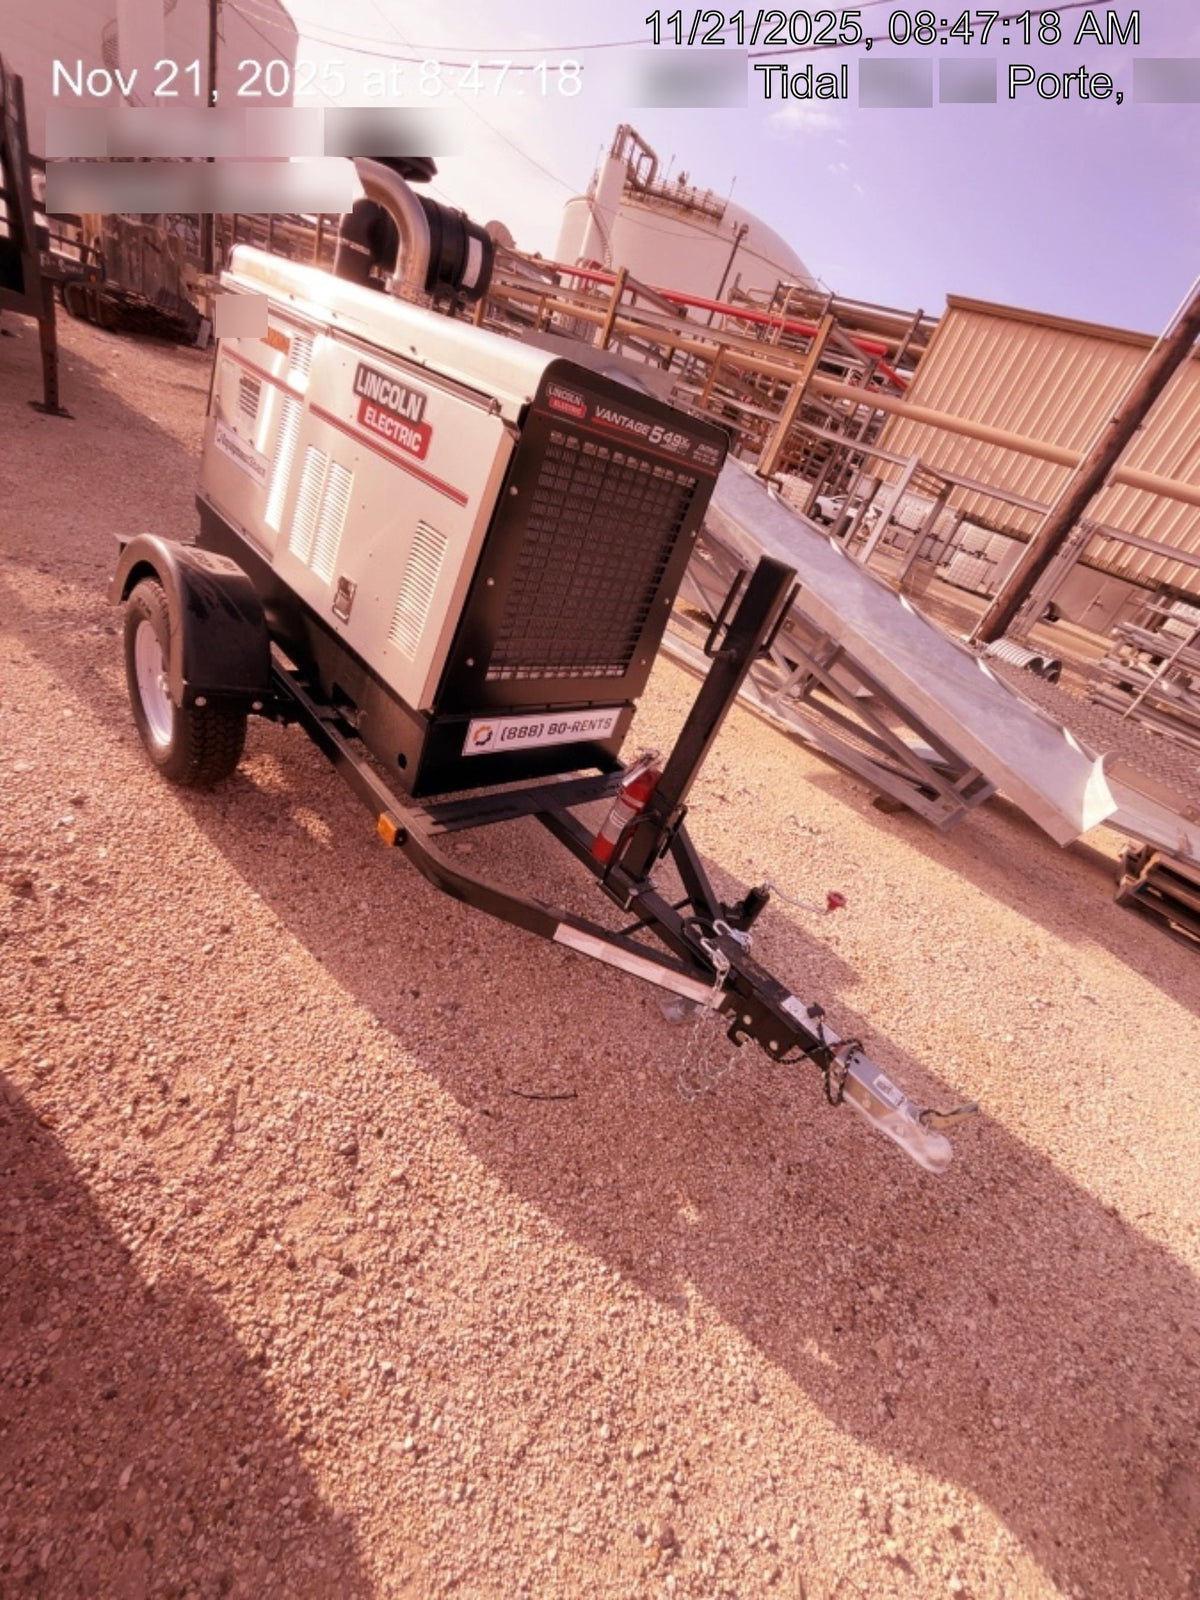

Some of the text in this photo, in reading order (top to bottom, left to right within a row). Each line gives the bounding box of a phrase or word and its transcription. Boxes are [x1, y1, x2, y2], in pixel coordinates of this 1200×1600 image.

[357, 368, 423, 422] LINCOLN
[364, 406, 423, 452] ELECTRIC
[594, 405, 651, 436] VANTAGE
[500, 723, 545, 742] (888)
